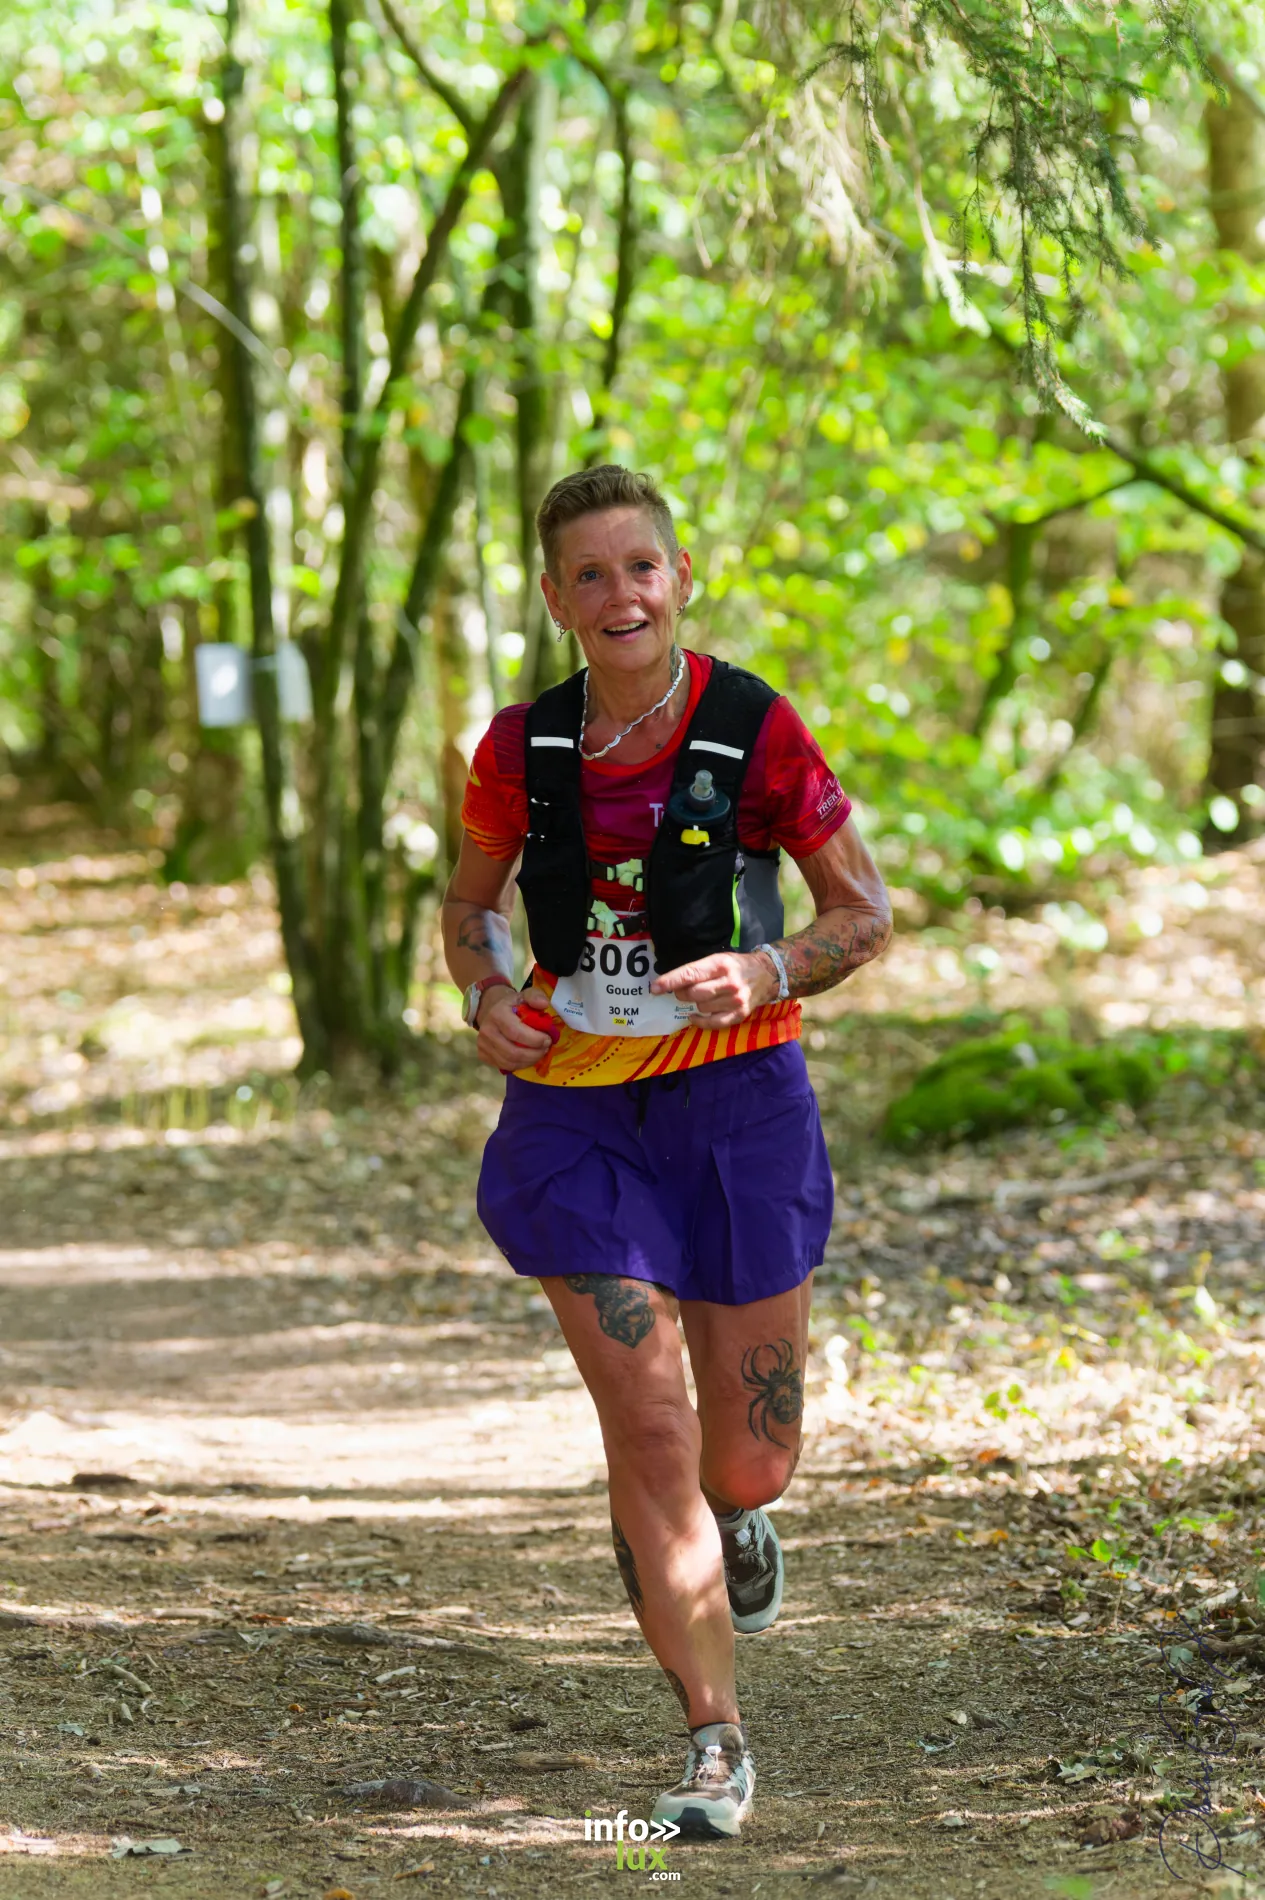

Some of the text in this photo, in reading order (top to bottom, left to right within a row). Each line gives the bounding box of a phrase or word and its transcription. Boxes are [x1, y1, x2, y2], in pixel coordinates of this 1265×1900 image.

[816, 791, 838, 816] TREK
[649, 803, 664, 827] T
[606, 984, 643, 996] Gouet
[608, 1005, 639, 1016] 30 KM
